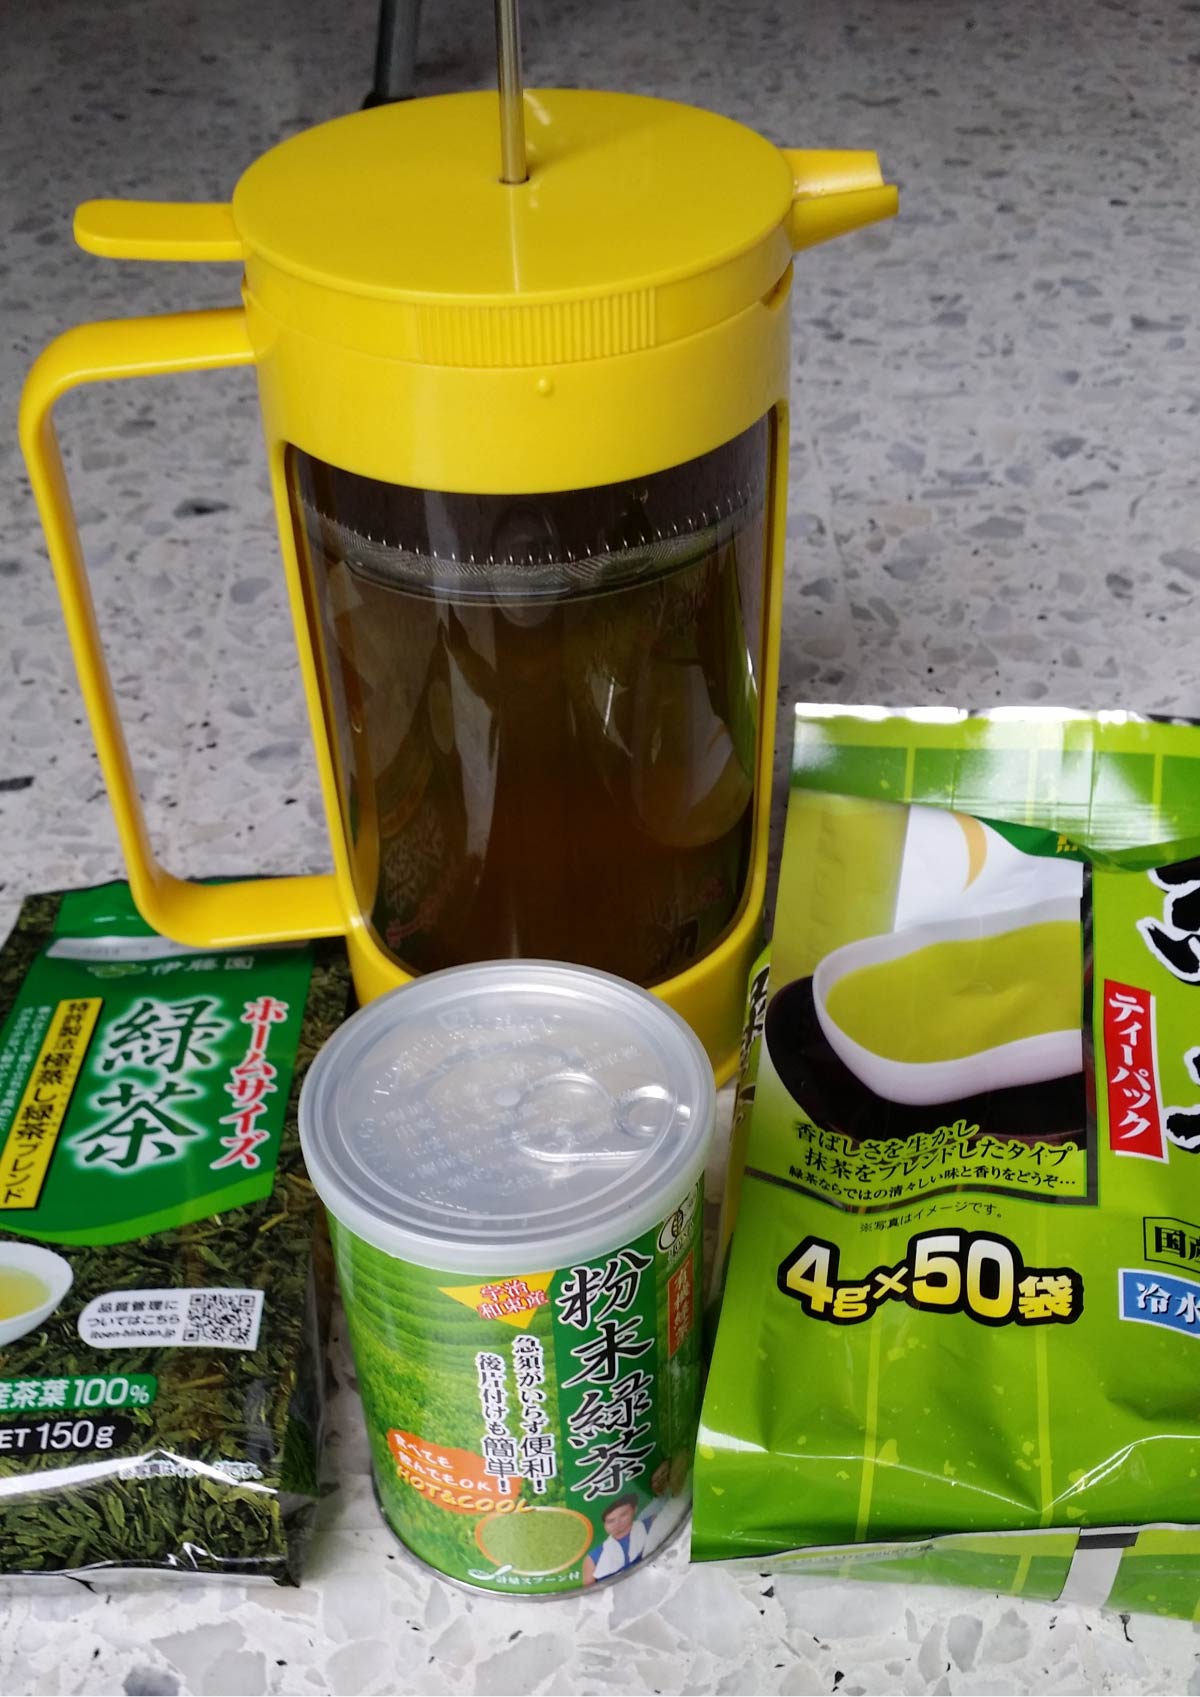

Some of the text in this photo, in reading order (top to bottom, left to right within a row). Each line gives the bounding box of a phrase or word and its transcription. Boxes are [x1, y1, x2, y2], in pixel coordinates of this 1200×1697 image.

[152, 957, 255, 976] 伊藤園
[1109, 991, 1151, 1139] ティーパック
[73, 996, 227, 1170] 緑茶
[210, 996, 289, 1169] ホームサイズ
[796, 1121, 977, 1158] 香ばしさを生かし
[804, 1140, 1073, 1182] 抹茶をブレンドしたタイプ
[859, 1201, 1003, 1232] ※写真はイメージです。
[481, 1279, 529, 1298] 宇治
[97, 1300, 179, 1313] 品質管理に
[477, 1290, 549, 1319] 和東産
[87, 1314, 181, 1328] ついてはこちら
[556, 1249, 654, 1501] 粉末緑茶
[74, 1377, 150, 1407] 100%
[36, 1420, 116, 1450] 150g
[394, 1433, 454, 1469] 食べても
[396, 1465, 536, 1513] HOT&COOL
[496, 1571, 581, 1585] 計量スプーン付
